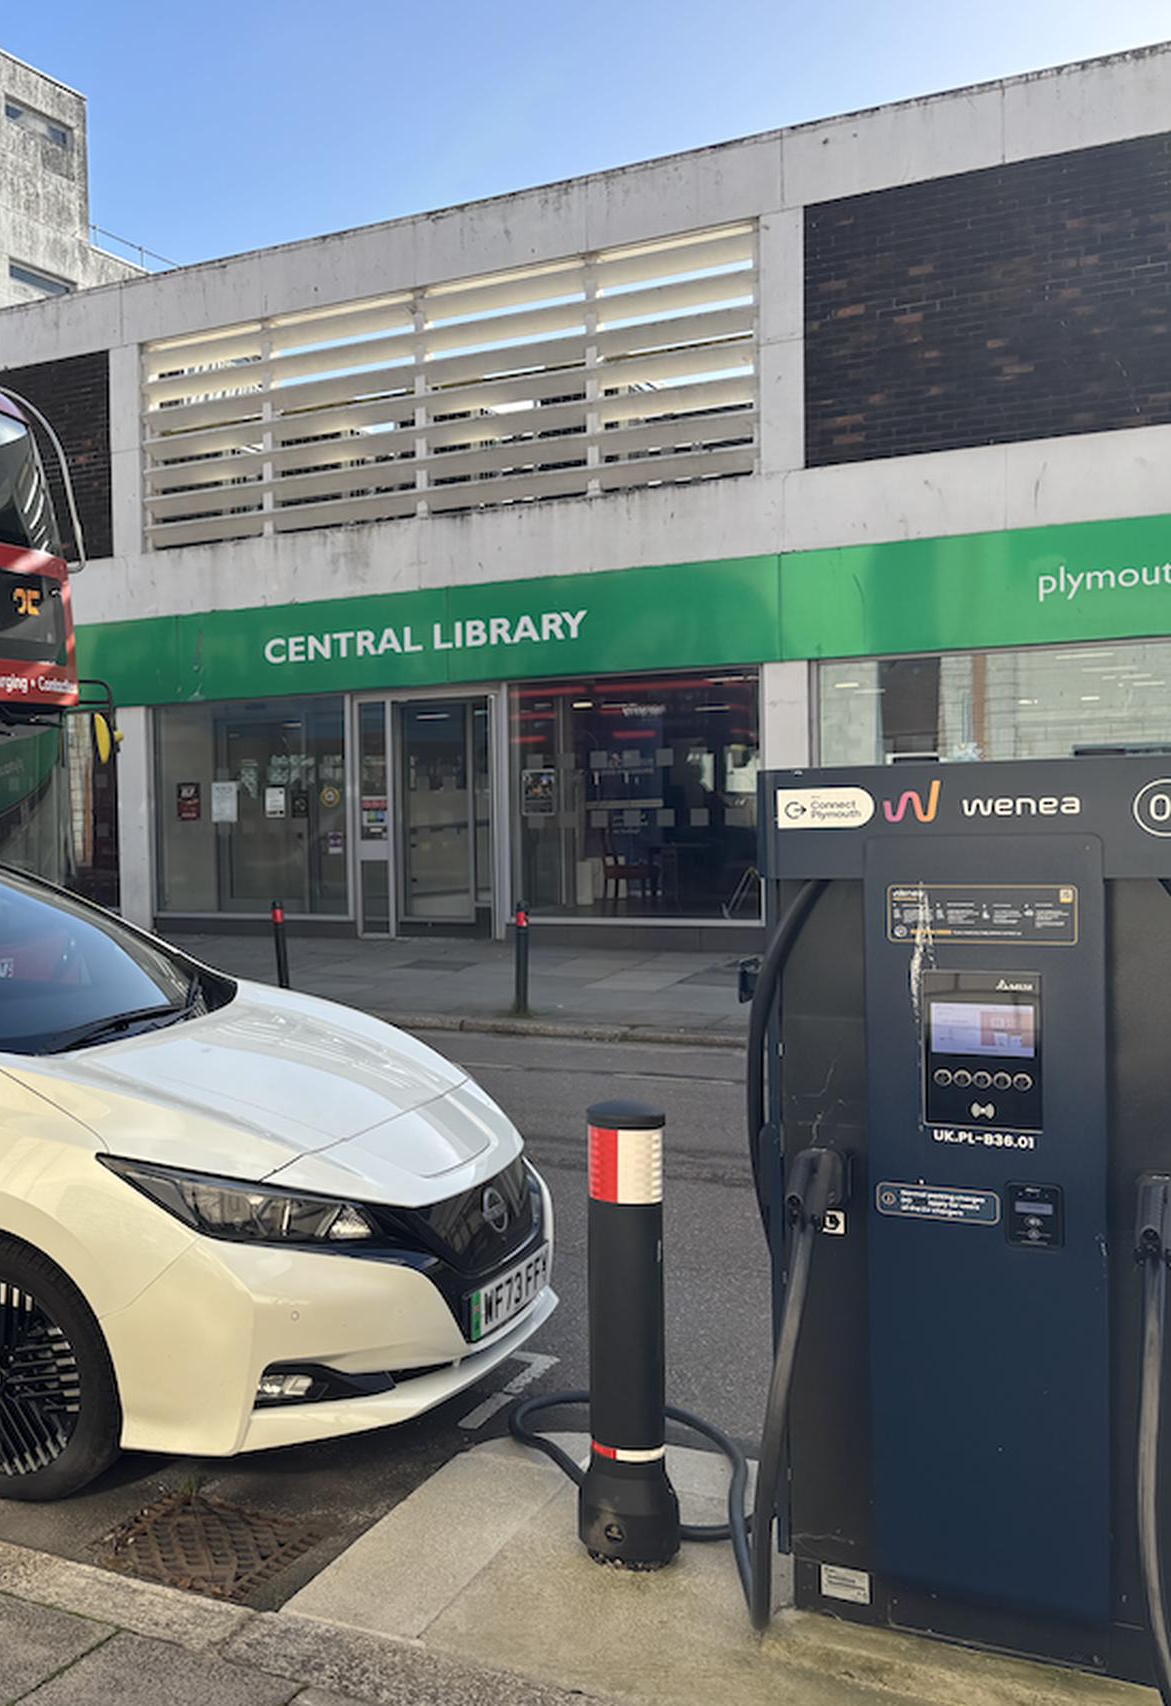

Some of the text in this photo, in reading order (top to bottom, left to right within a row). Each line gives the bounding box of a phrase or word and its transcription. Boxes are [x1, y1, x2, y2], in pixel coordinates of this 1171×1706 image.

[264, 610, 588, 663] CENTRAL LIBRARY
[810, 800, 856, 810] Connect
[961, 796, 1081, 818] wenea
[810, 810, 862, 821] Plymouth
